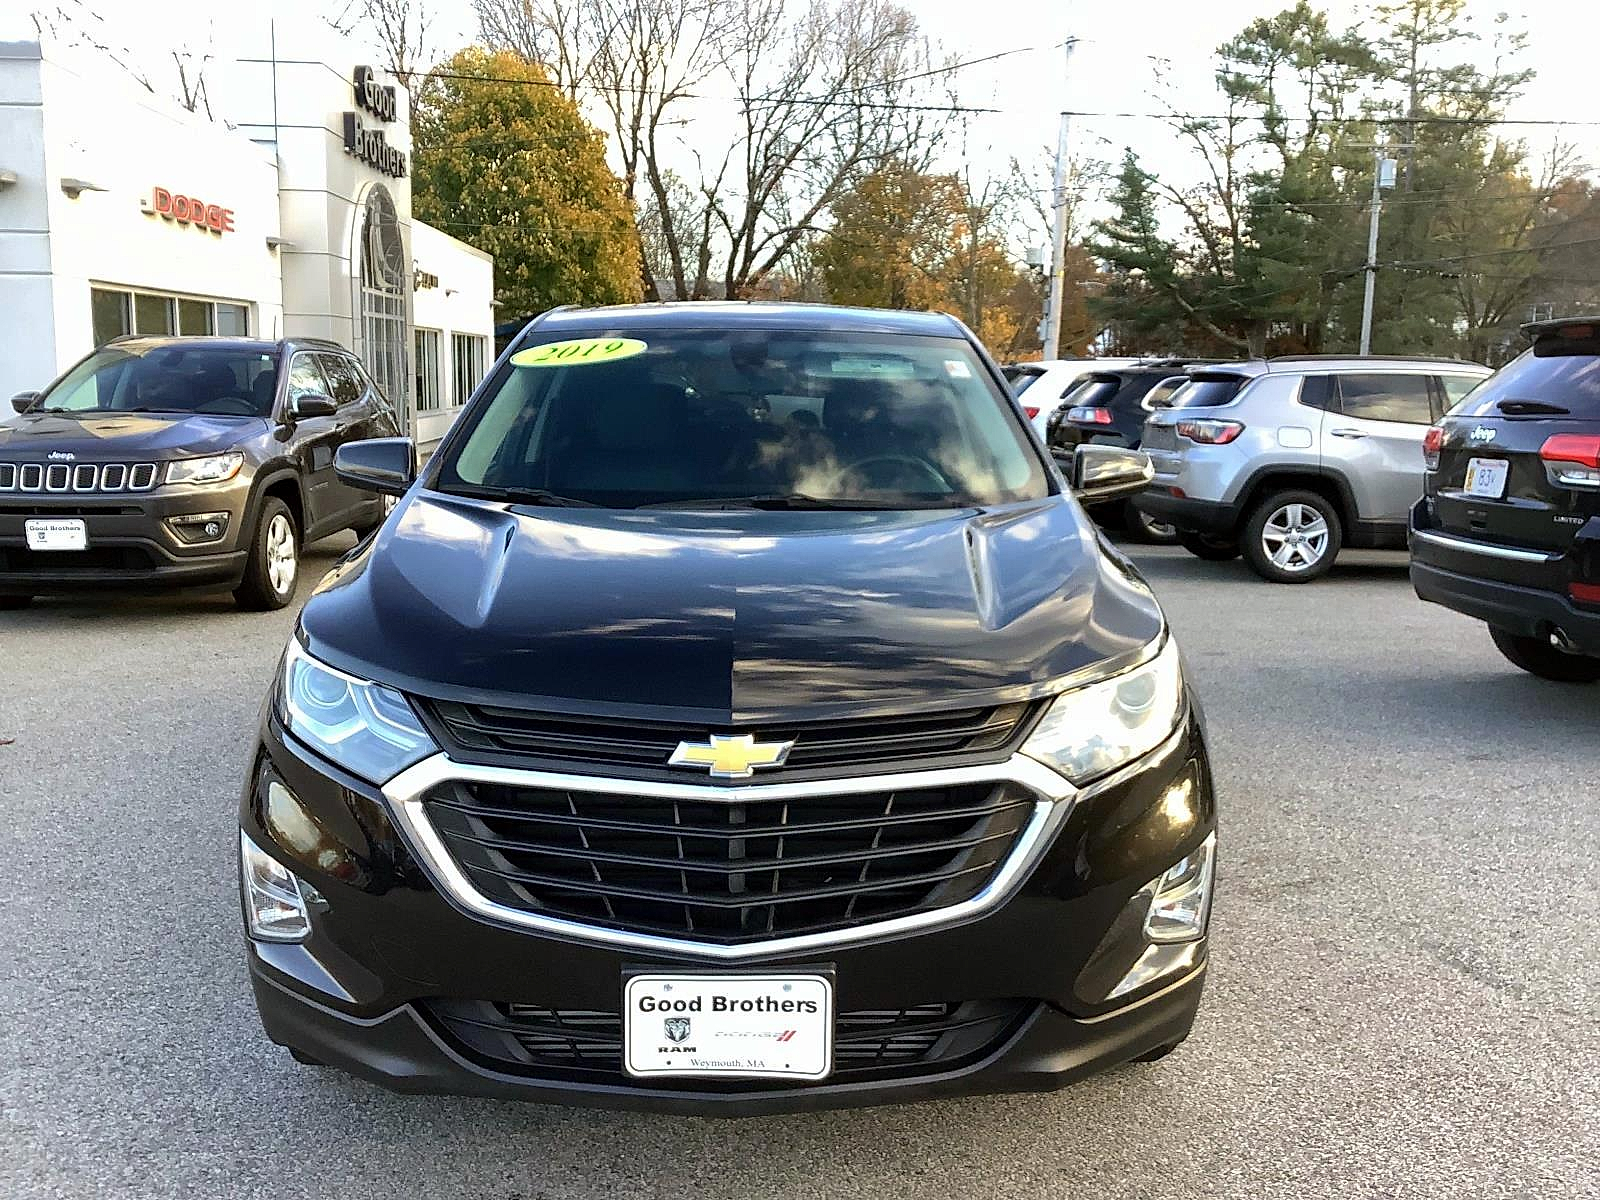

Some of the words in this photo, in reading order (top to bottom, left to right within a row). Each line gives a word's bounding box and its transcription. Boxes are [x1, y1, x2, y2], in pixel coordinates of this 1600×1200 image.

[353, 65, 397, 122] Good
[343, 112, 407, 178] Brothers
[153, 186, 234, 232] DODGE
[534, 341, 623, 361] 2019
[1470, 424, 1497, 443] Jeep
[1553, 515, 1584, 525] LIMITED
[638, 996, 702, 1012] Good
[712, 996, 818, 1013] Brothers
[690, 1058, 744, 1069] Weymouth,
[746, 1059, 766, 1068] MA
